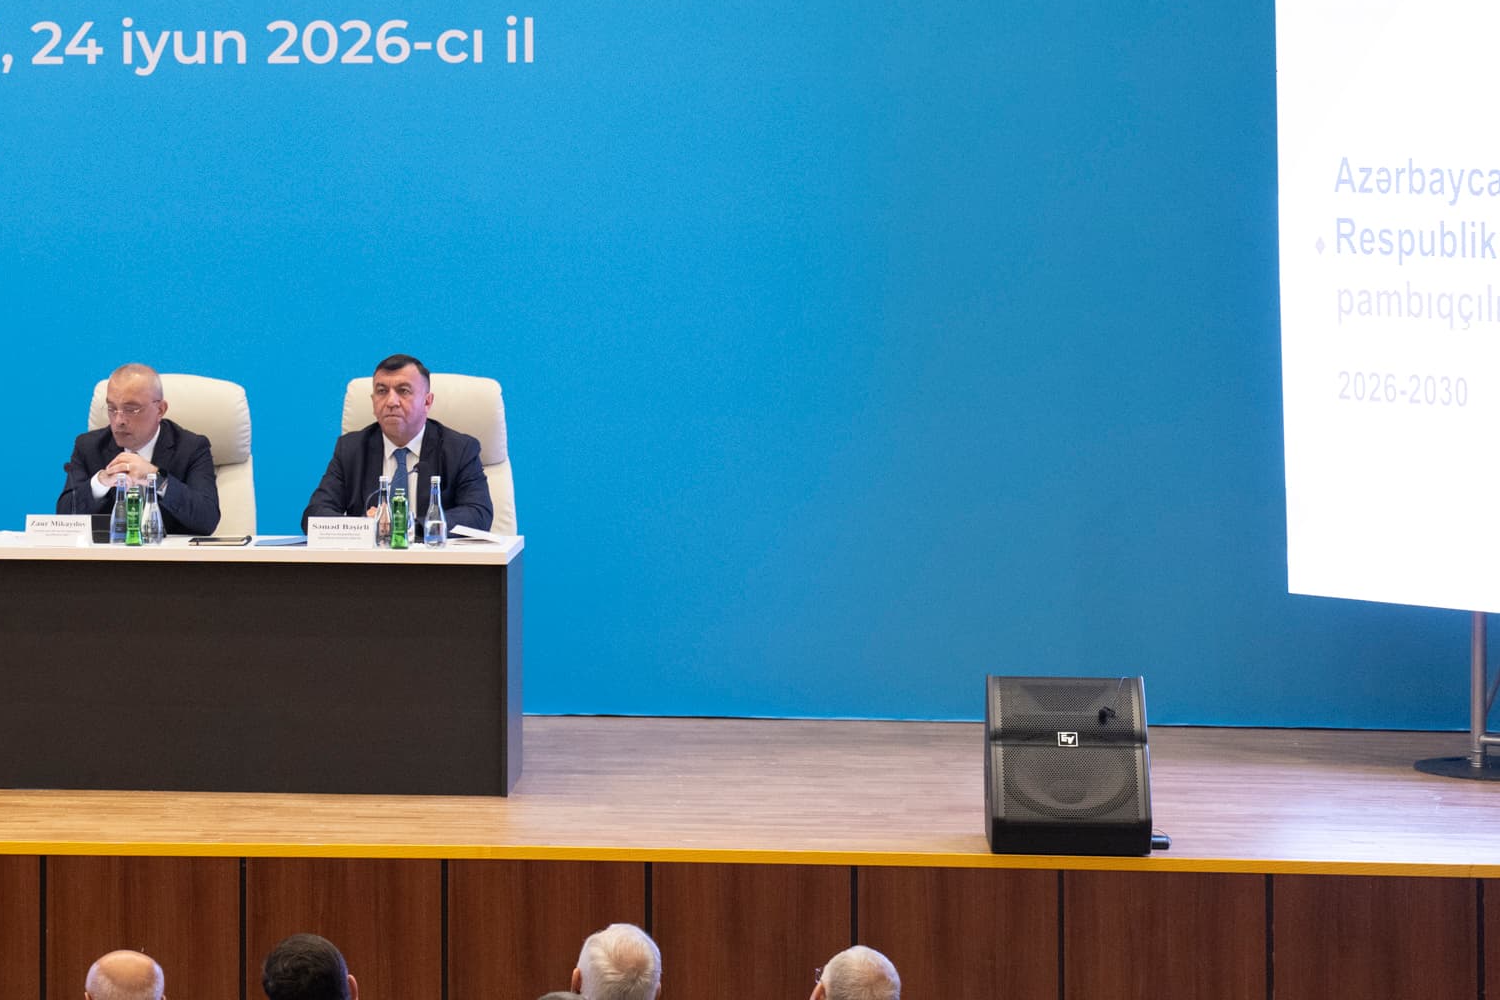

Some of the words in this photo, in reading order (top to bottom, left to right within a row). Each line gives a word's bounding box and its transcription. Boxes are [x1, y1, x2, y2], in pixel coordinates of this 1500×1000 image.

[30, 21, 104, 65] 24
[122, 17, 247, 76] iyun
[266, 19, 483, 65] 2026-cı
[506, 15, 534, 63] il
[1335, 216, 1498, 267] Respublik
[1338, 370, 1468, 408] 2026-2030
